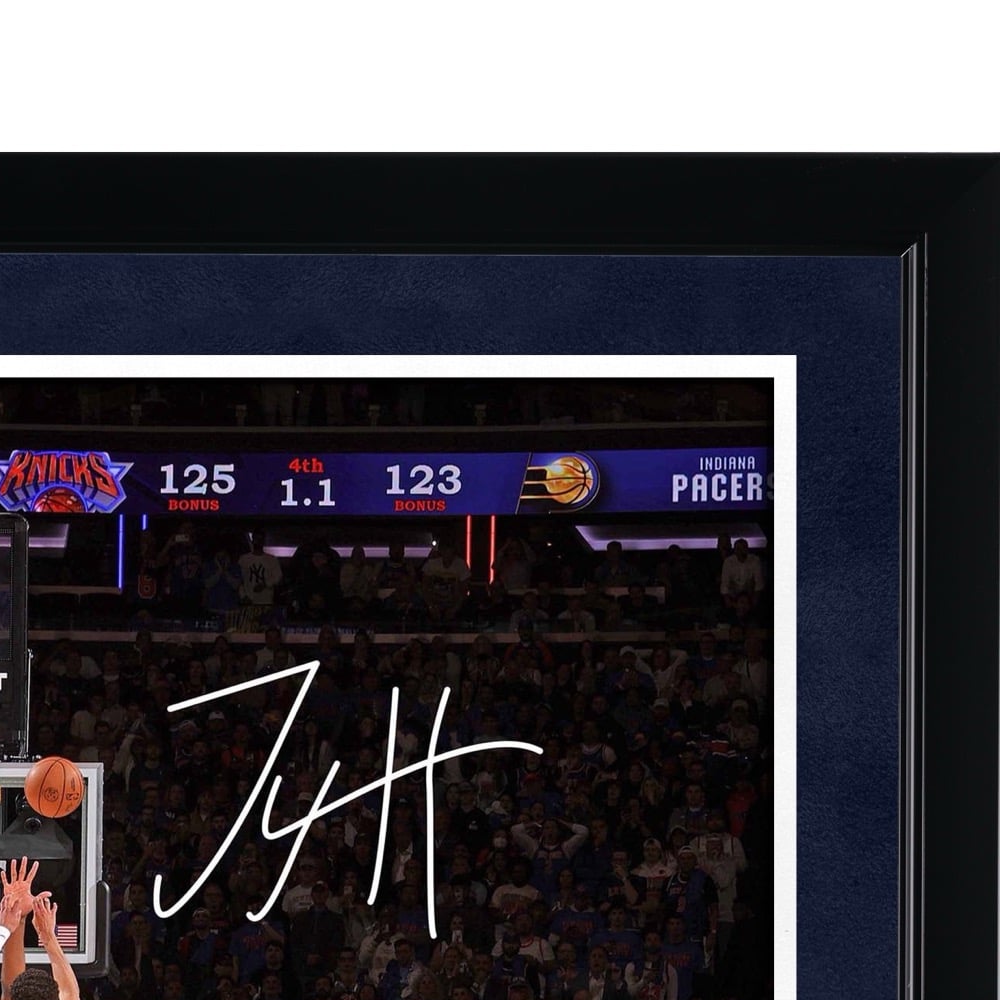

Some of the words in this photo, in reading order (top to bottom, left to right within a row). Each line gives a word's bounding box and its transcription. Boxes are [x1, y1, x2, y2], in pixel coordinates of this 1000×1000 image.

[288, 458, 325, 473] 4th
[700, 456, 756, 471] INDIANA
[0, 451, 120, 499] KNICKS
[160, 463, 236, 495] 125
[386, 464, 462, 495] 123
[281, 478, 336, 506] 1.1
[168, 498, 220, 511] BONUS
[394, 499, 446, 511] BONUS
